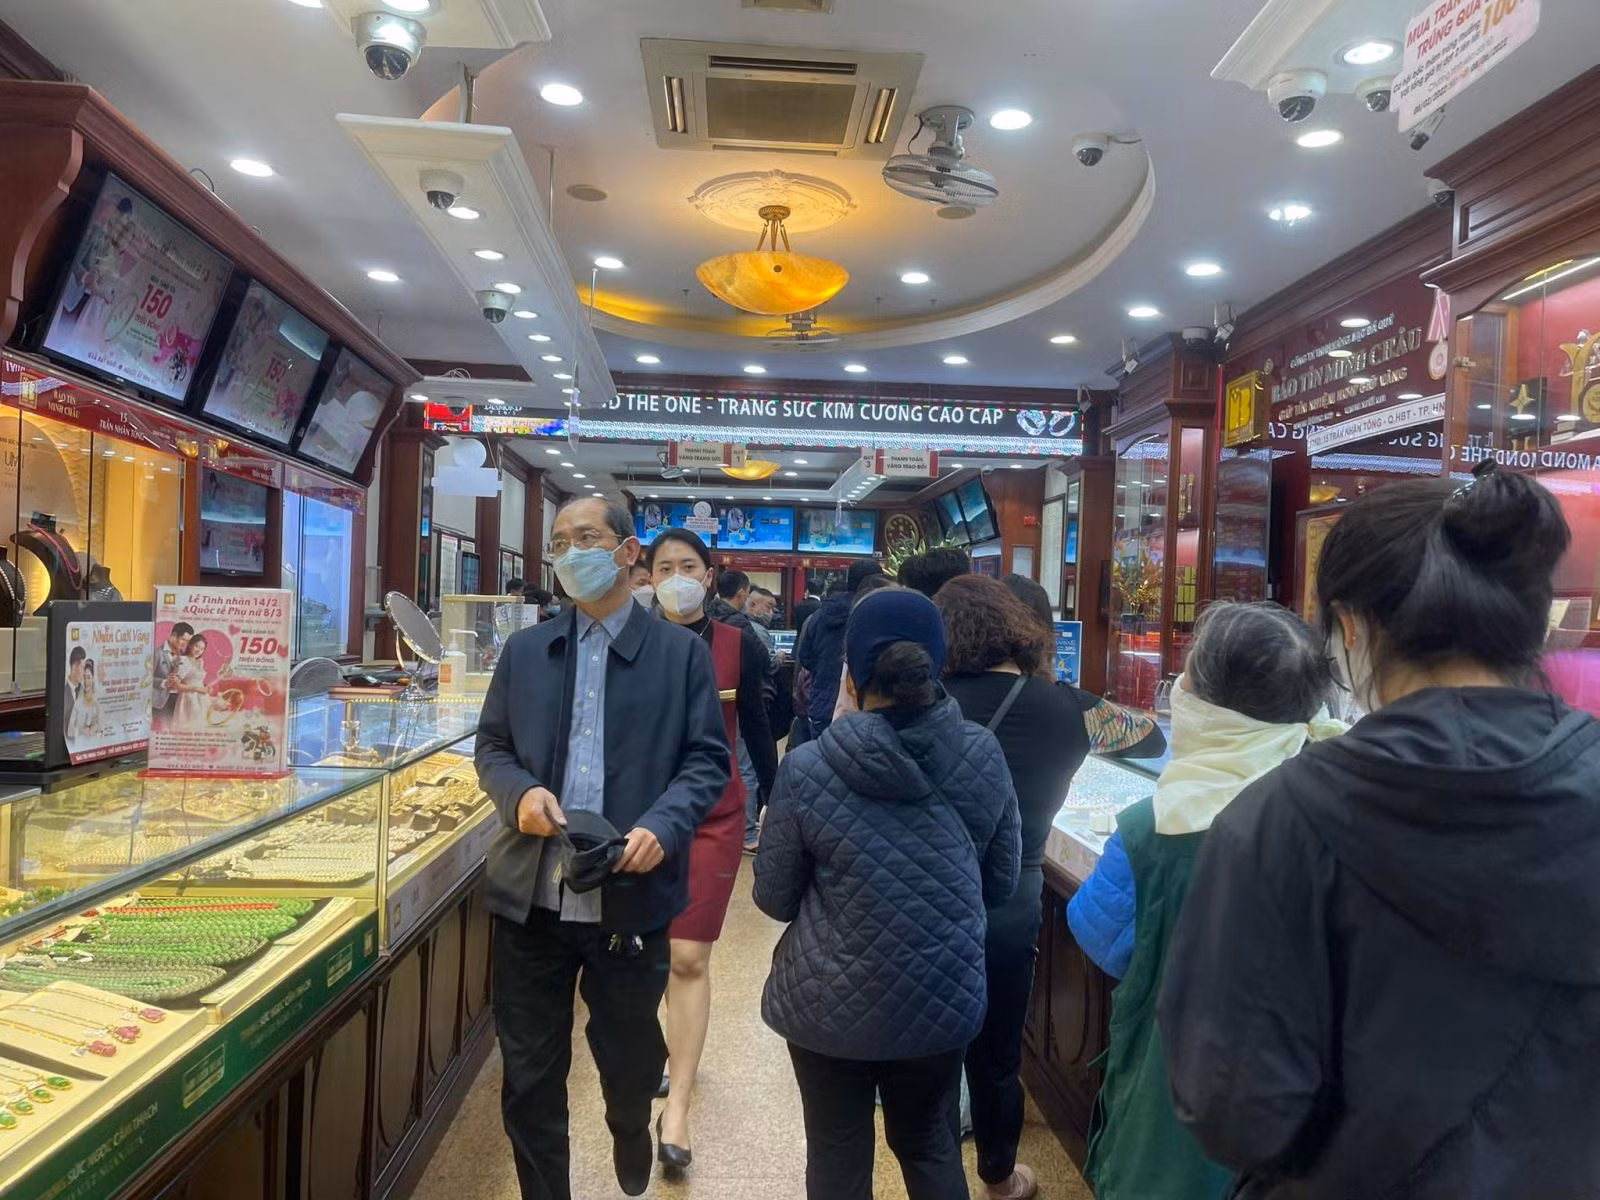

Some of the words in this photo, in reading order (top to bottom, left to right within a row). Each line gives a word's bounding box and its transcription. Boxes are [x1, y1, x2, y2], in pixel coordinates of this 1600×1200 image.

[1407, 17, 1430, 48] MUA
[141, 283, 173, 319] 150
[264, 356, 287, 383] 150
[626, 394, 659, 412] THE
[665, 396, 701, 414] ONE
[718, 397, 777, 417] TRANG
[822, 401, 854, 419] KIM
[928, 405, 964, 424] CAO
[736, 455, 741, 463] 1
[865, 460, 872, 469] 3
[253, 597, 278, 607] 14/2
[263, 609, 282, 618] 8/3
[239, 636, 279, 655] 150
